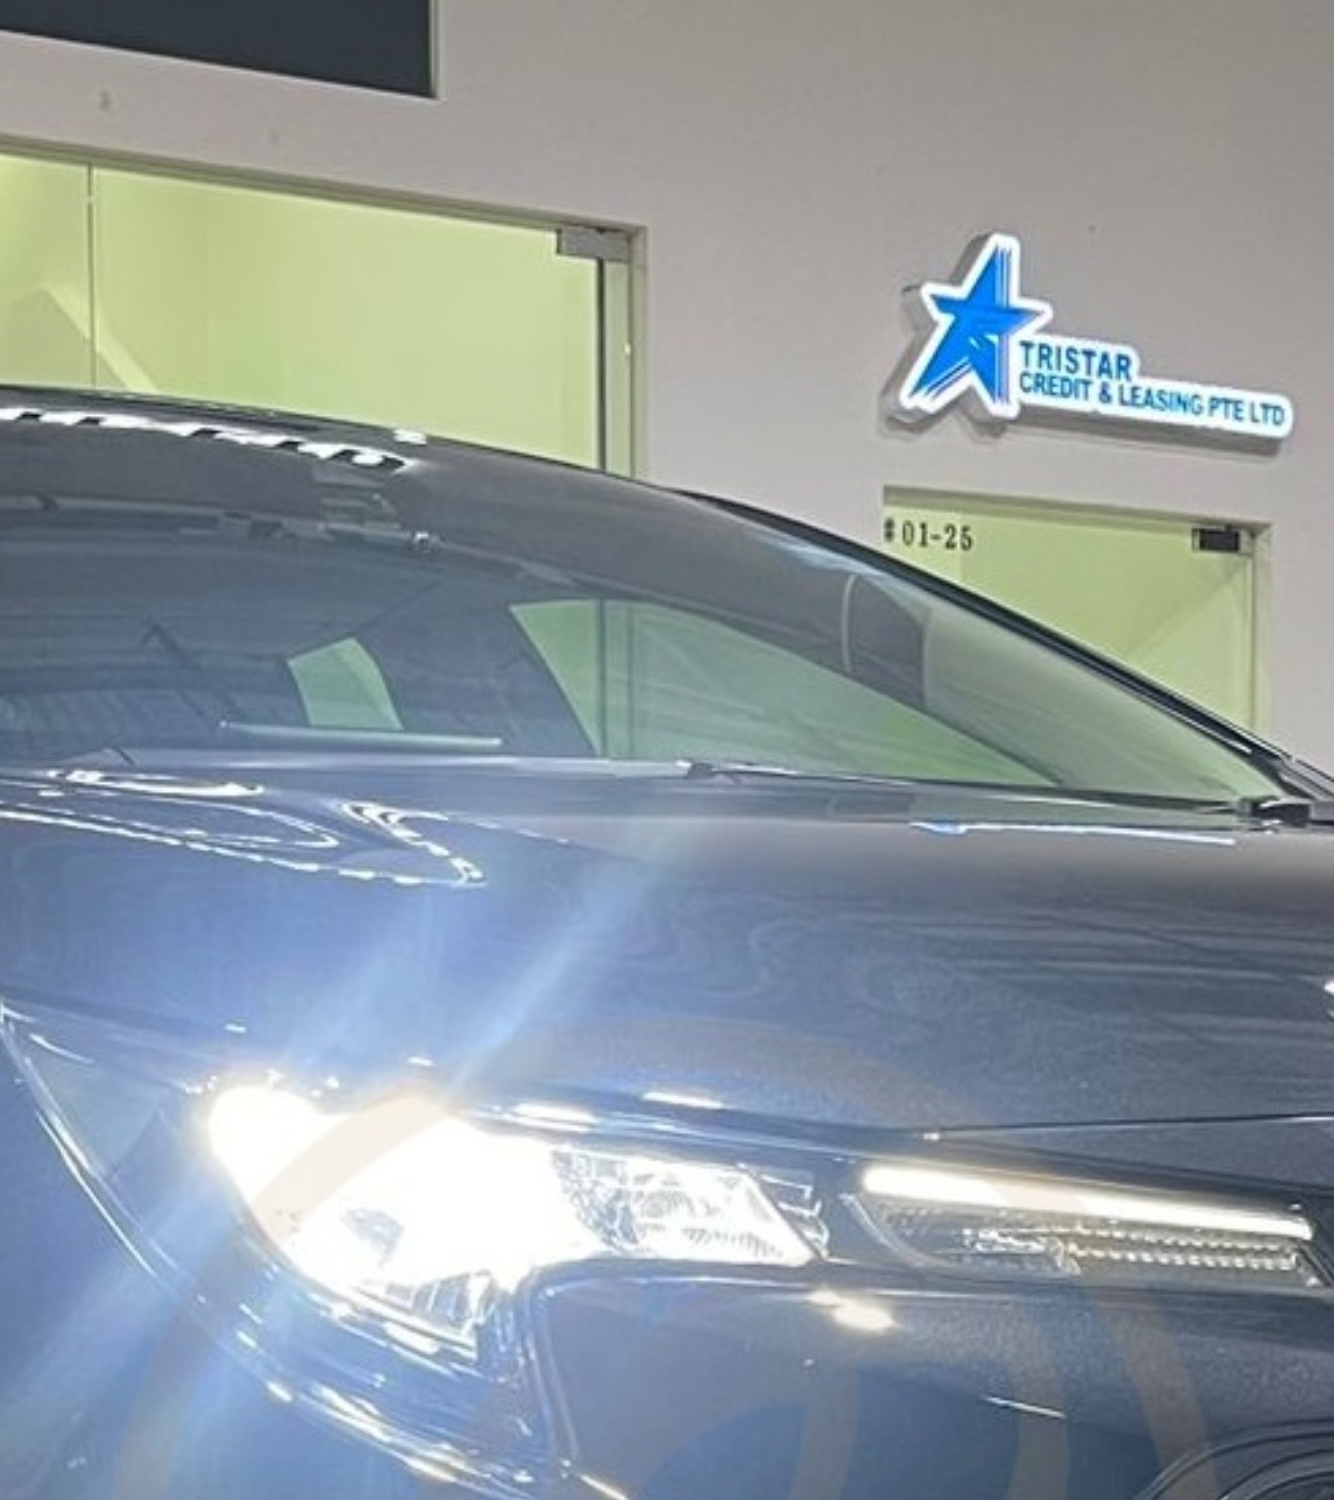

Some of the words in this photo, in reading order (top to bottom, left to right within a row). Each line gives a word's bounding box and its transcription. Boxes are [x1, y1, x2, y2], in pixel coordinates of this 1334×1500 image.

[1019, 340, 1132, 381] TRISTAR
[1019, 371, 1093, 400] CREDIT
[1098, 381, 1113, 403] &
[1118, 384, 1203, 416] LEASING
[1208, 396, 1244, 422] PTE
[1249, 401, 1285, 426] LTD
